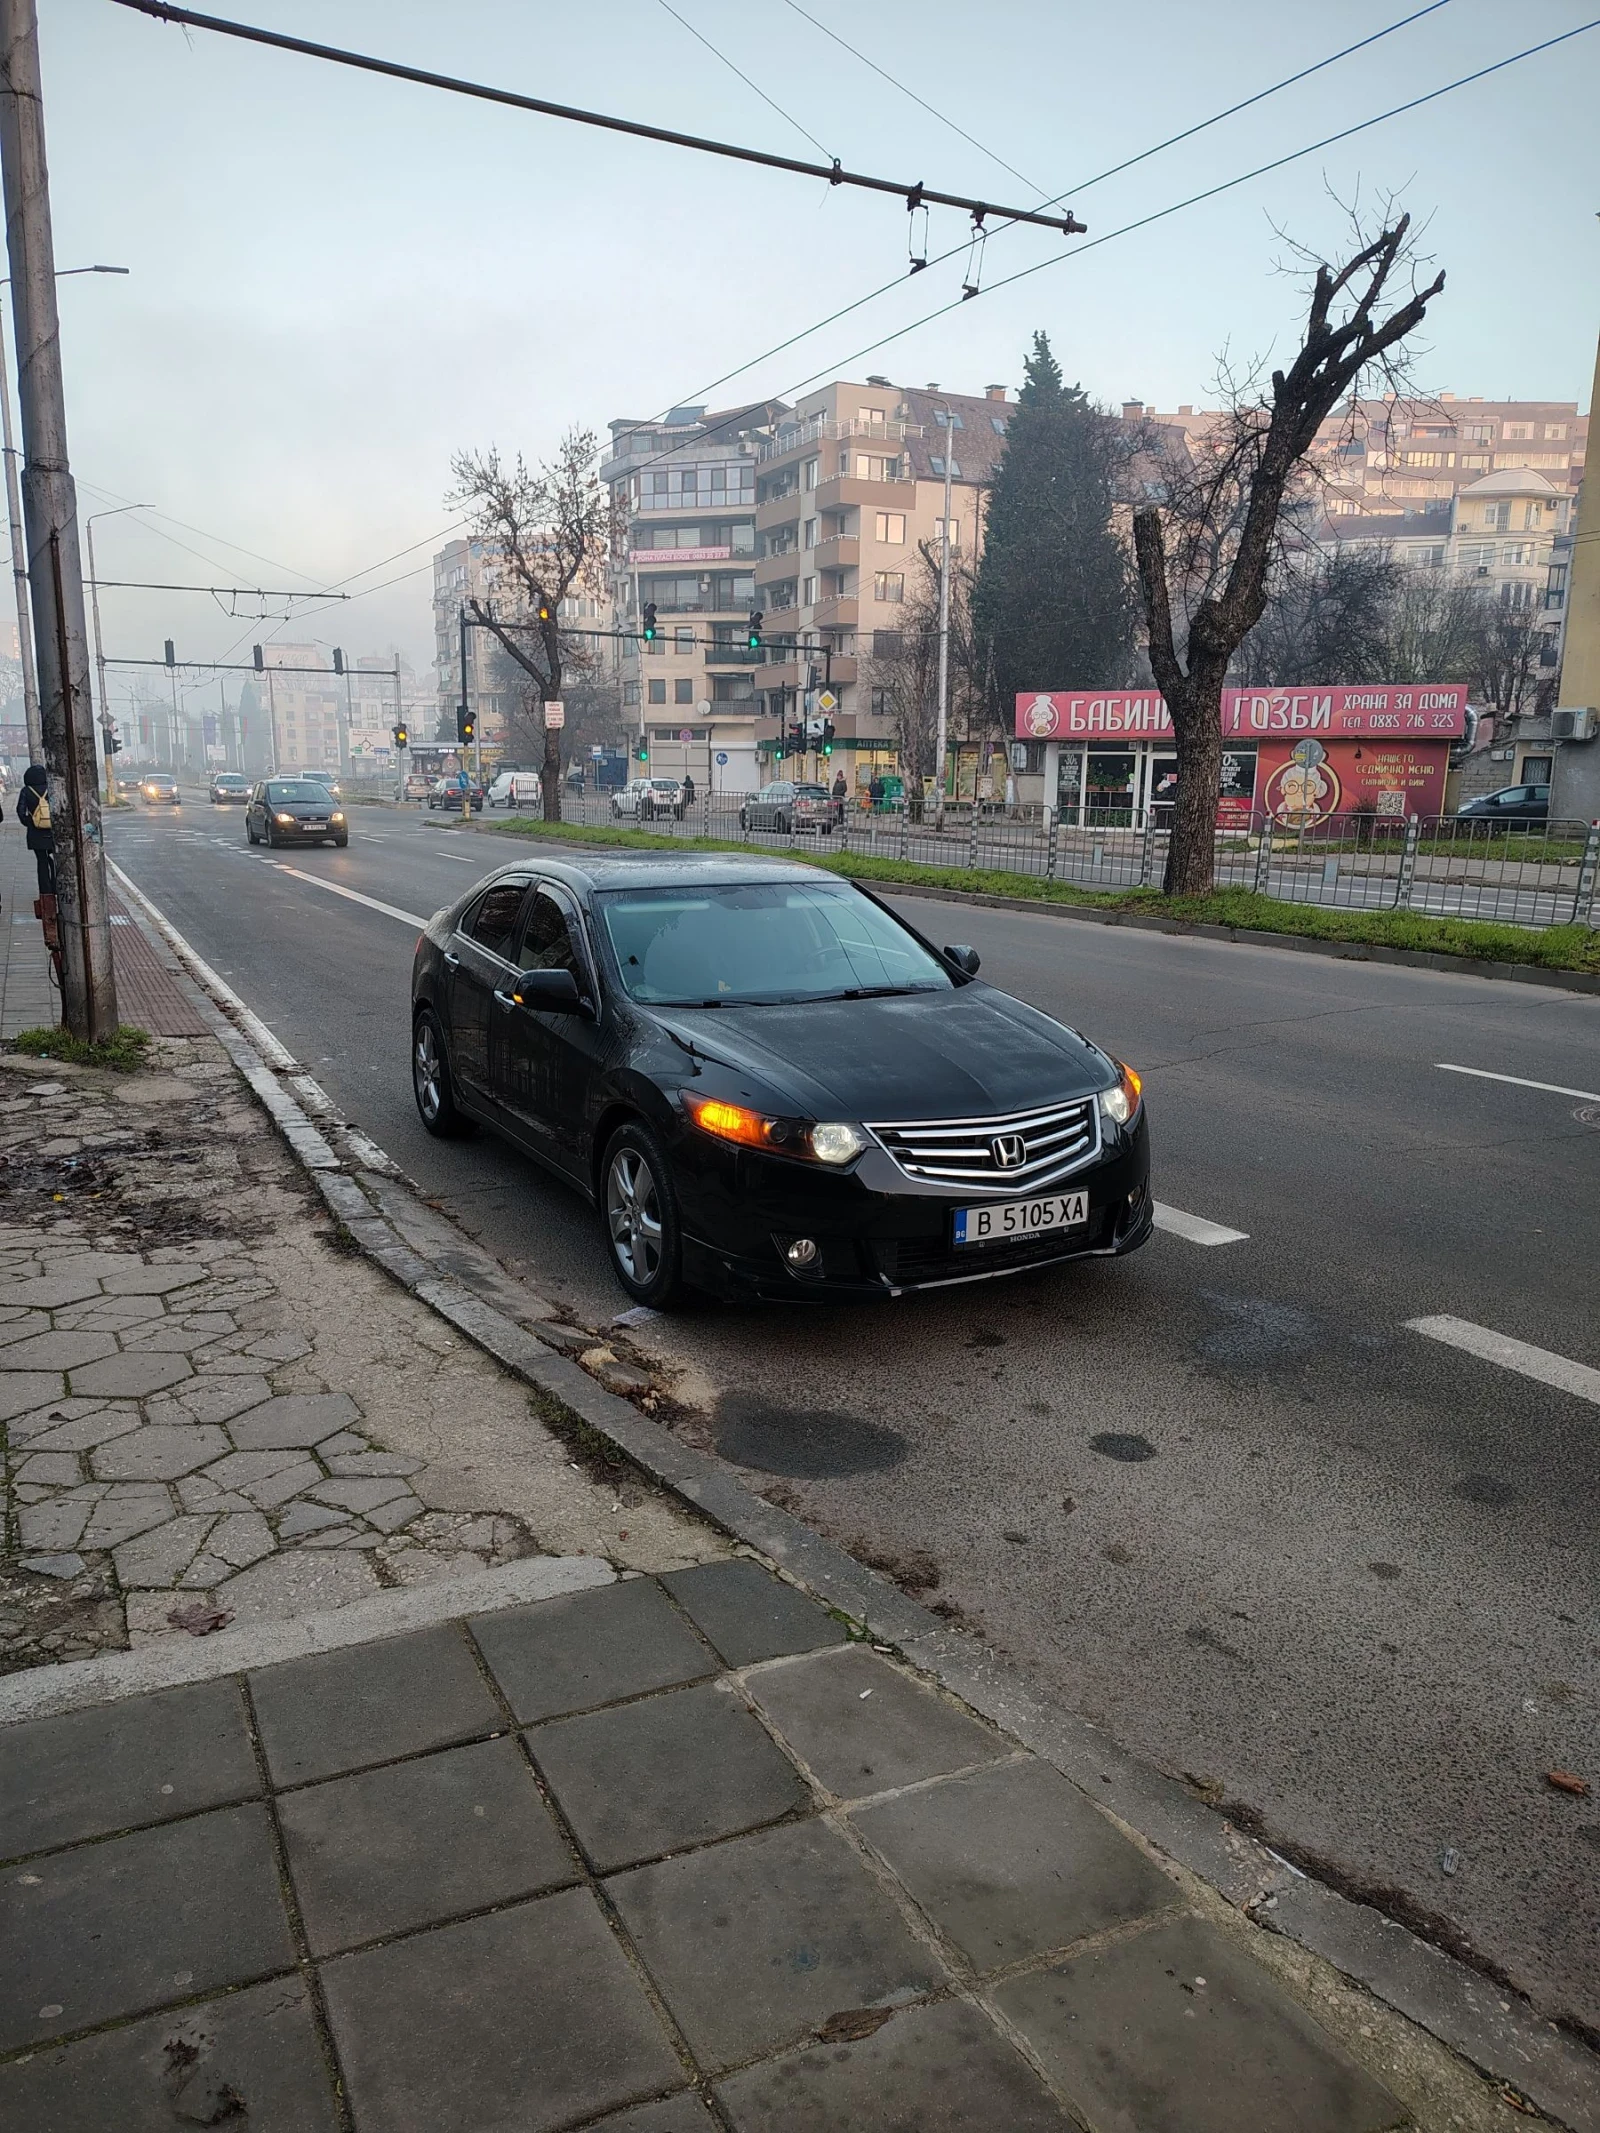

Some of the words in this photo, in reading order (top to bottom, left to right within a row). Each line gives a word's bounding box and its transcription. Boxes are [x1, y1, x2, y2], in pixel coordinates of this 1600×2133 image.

[1343, 694, 1388, 710] ХРАНА
[1394, 693, 1412, 710] ЗА
[1418, 693, 1458, 711] ДОМА
[1233, 695, 1332, 730] ГОЗБИ
[1369, 714, 1401, 728] 0885
[1406, 714, 1425, 728] 716
[1430, 714, 1455, 728] 325
[857, 740, 889, 748] АПТЕКА
[1378, 754, 1414, 764] НАШЕТО
[1356, 765, 1404, 775] СЕДМИЧНО
[1408, 765, 1435, 775] МЕНЮ
[977, 1211, 992, 1236] B
[1003, 1201, 1054, 1232] 5105
[1059, 1196, 1083, 1223] XA
[1010, 1232, 1040, 1242] HONDA
